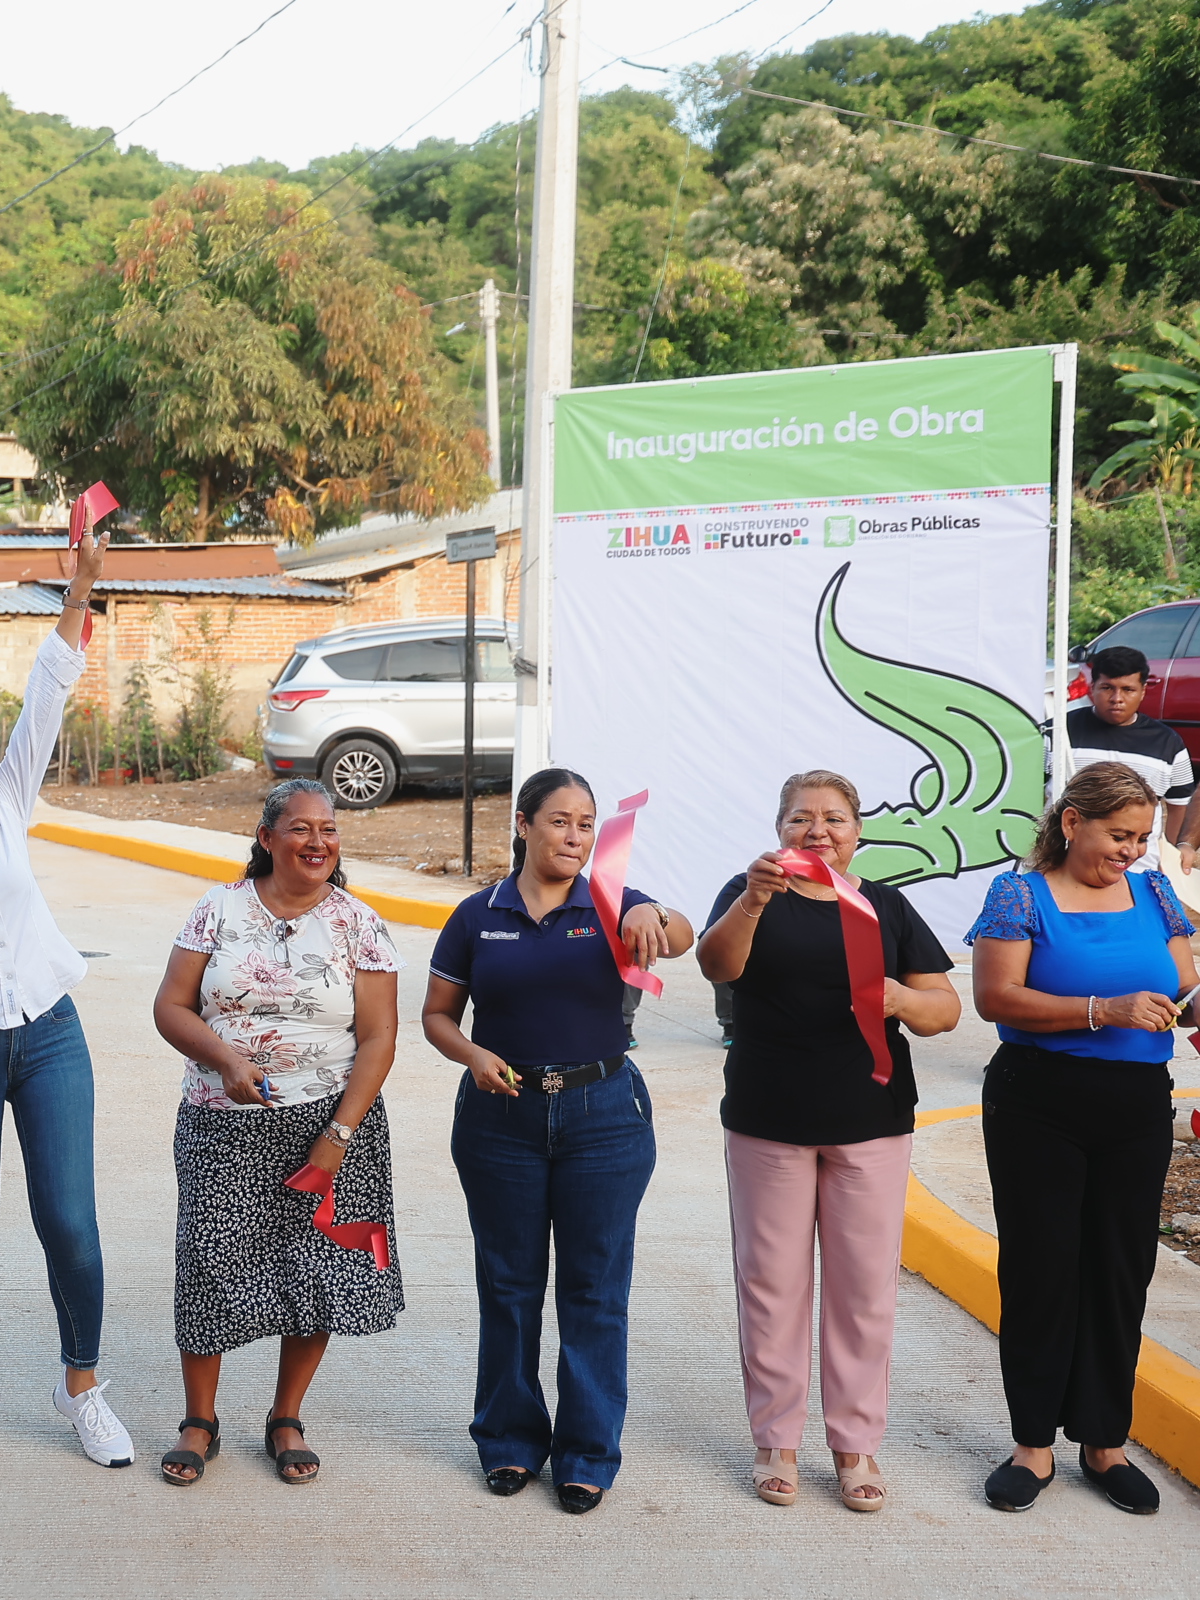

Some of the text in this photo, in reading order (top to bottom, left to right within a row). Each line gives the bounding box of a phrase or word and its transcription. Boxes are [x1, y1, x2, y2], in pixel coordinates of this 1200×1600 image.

[607, 404, 984, 463] Inauguración de Obra
[704, 517, 809, 533] CONSTRUYENDO
[858, 515, 981, 534] Obras Públicas
[607, 524, 690, 548] ZIHUA
[720, 532, 792, 549] Futuro
[606, 547, 691, 559] CIUDAD DE TODOS
[566, 926, 596, 935] ZIHUA
